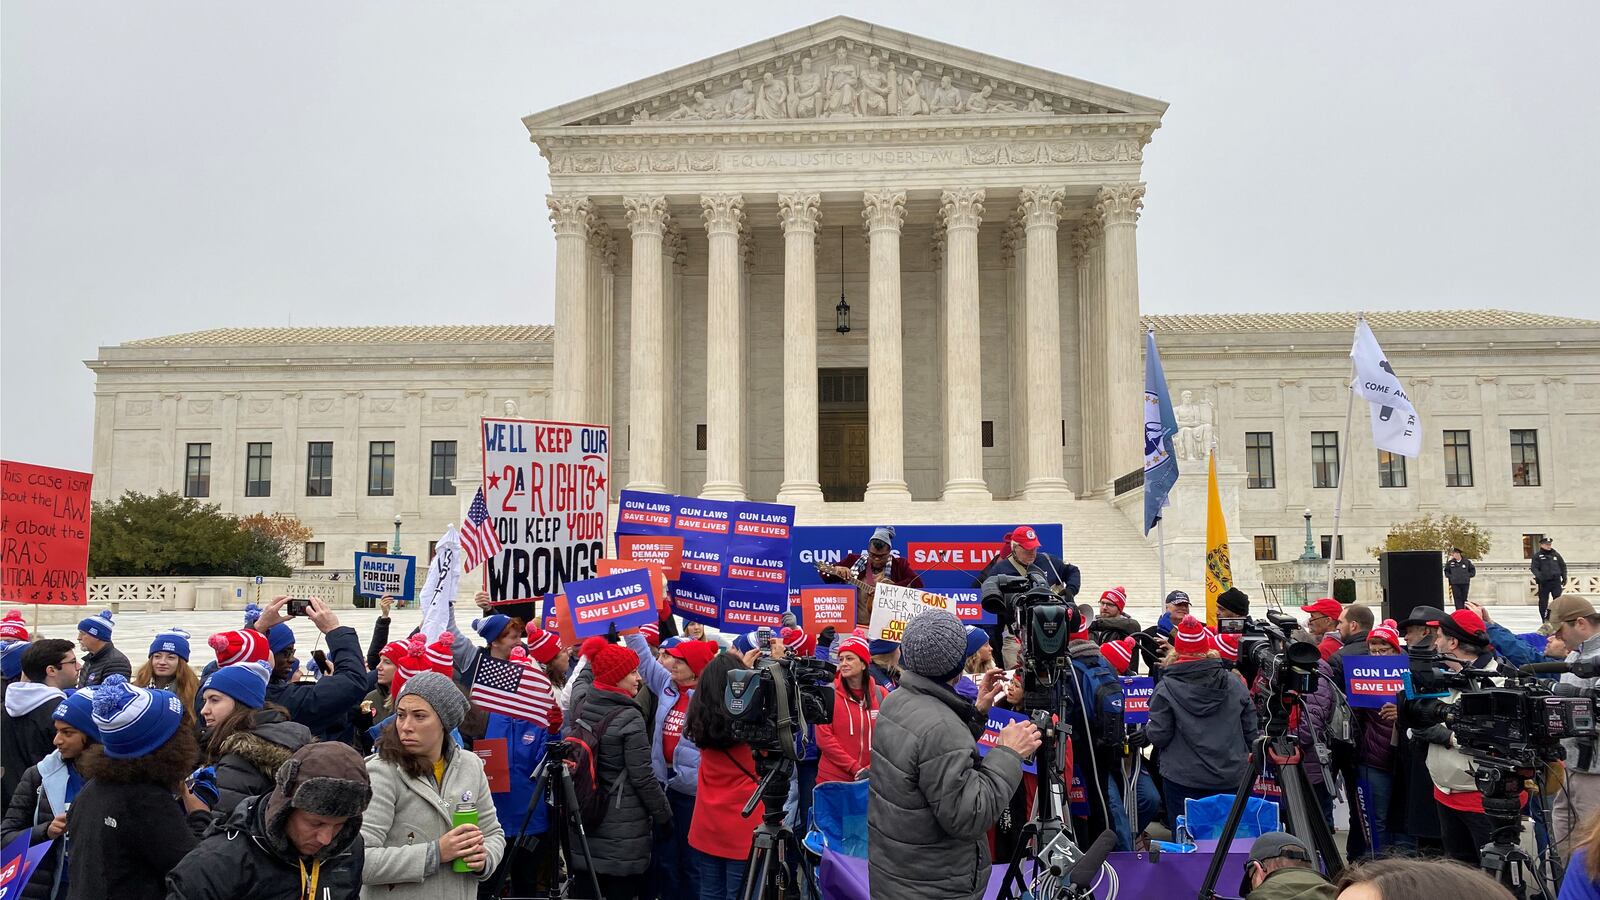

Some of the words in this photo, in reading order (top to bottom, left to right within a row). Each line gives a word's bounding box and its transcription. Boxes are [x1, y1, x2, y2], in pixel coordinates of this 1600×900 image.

[732, 154, 786, 167] EQUAL
[792, 153, 852, 166] JUSTICE
[862, 151, 916, 164] UNDER
[920, 150, 953, 162] LAW
[1365, 382, 1390, 394] COME
[535, 426, 572, 453] KEEP
[581, 428, 608, 454] OUR
[28, 473, 62, 490] case
[502, 464, 525, 512] 2A
[531, 462, 596, 518] RIGHTS
[32, 492, 52, 507] the
[625, 501, 644, 510] GUN
[646, 504, 670, 512] LAWS
[624, 512, 644, 520] SAVE
[646, 515, 668, 524] LIVES
[680, 508, 701, 516] GUN
[702, 510, 728, 519] LAWS
[739, 512, 760, 521] GUN
[761, 514, 787, 524] LAWS
[16, 520, 56, 538] about
[61, 526, 84, 540] the
[526, 518, 561, 544] KEEP
[566, 512, 604, 541] YOUR
[678, 520, 700, 528] SAVE
[702, 522, 726, 530] LIVES
[738, 524, 759, 533] SAVE
[760, 526, 786, 536] LIVES
[694, 552, 720, 560] LAWS
[732, 556, 754, 565] GUN
[756, 558, 784, 568] LAWS
[800, 550, 840, 563] GUN
[914, 549, 964, 563] SAVE
[970, 549, 1000, 563] LIV
[363, 560, 394, 572] MARCH
[488, 541, 604, 602] WRONGS
[694, 564, 718, 572] LIVES
[41, 570, 86, 590] AGENDA
[363, 571, 379, 581] FOR
[380, 572, 400, 582] OUR
[732, 568, 754, 577] SAVE
[756, 570, 782, 580] LIVES
[364, 582, 385, 592] LIVES
[576, 592, 604, 604] GUN
[606, 584, 642, 597] LAWS
[676, 588, 692, 598] GUN
[694, 592, 716, 603] LAWS
[880, 586, 898, 597] WHY
[902, 588, 919, 600] ARE
[922, 593, 948, 609] GUNS
[580, 606, 609, 620] SAVE
[612, 599, 645, 614] LIVES
[676, 600, 694, 610] SAVE
[695, 604, 716, 615] LIVES
[728, 600, 750, 609] GUN
[752, 603, 780, 612] LAWS
[878, 598, 908, 612] EASIER
[728, 612, 751, 621] SAVE
[753, 615, 780, 624] LIVES
[1353, 668, 1380, 677] GUN
[1354, 683, 1384, 691] SAVE
[986, 720, 1003, 730] UN
